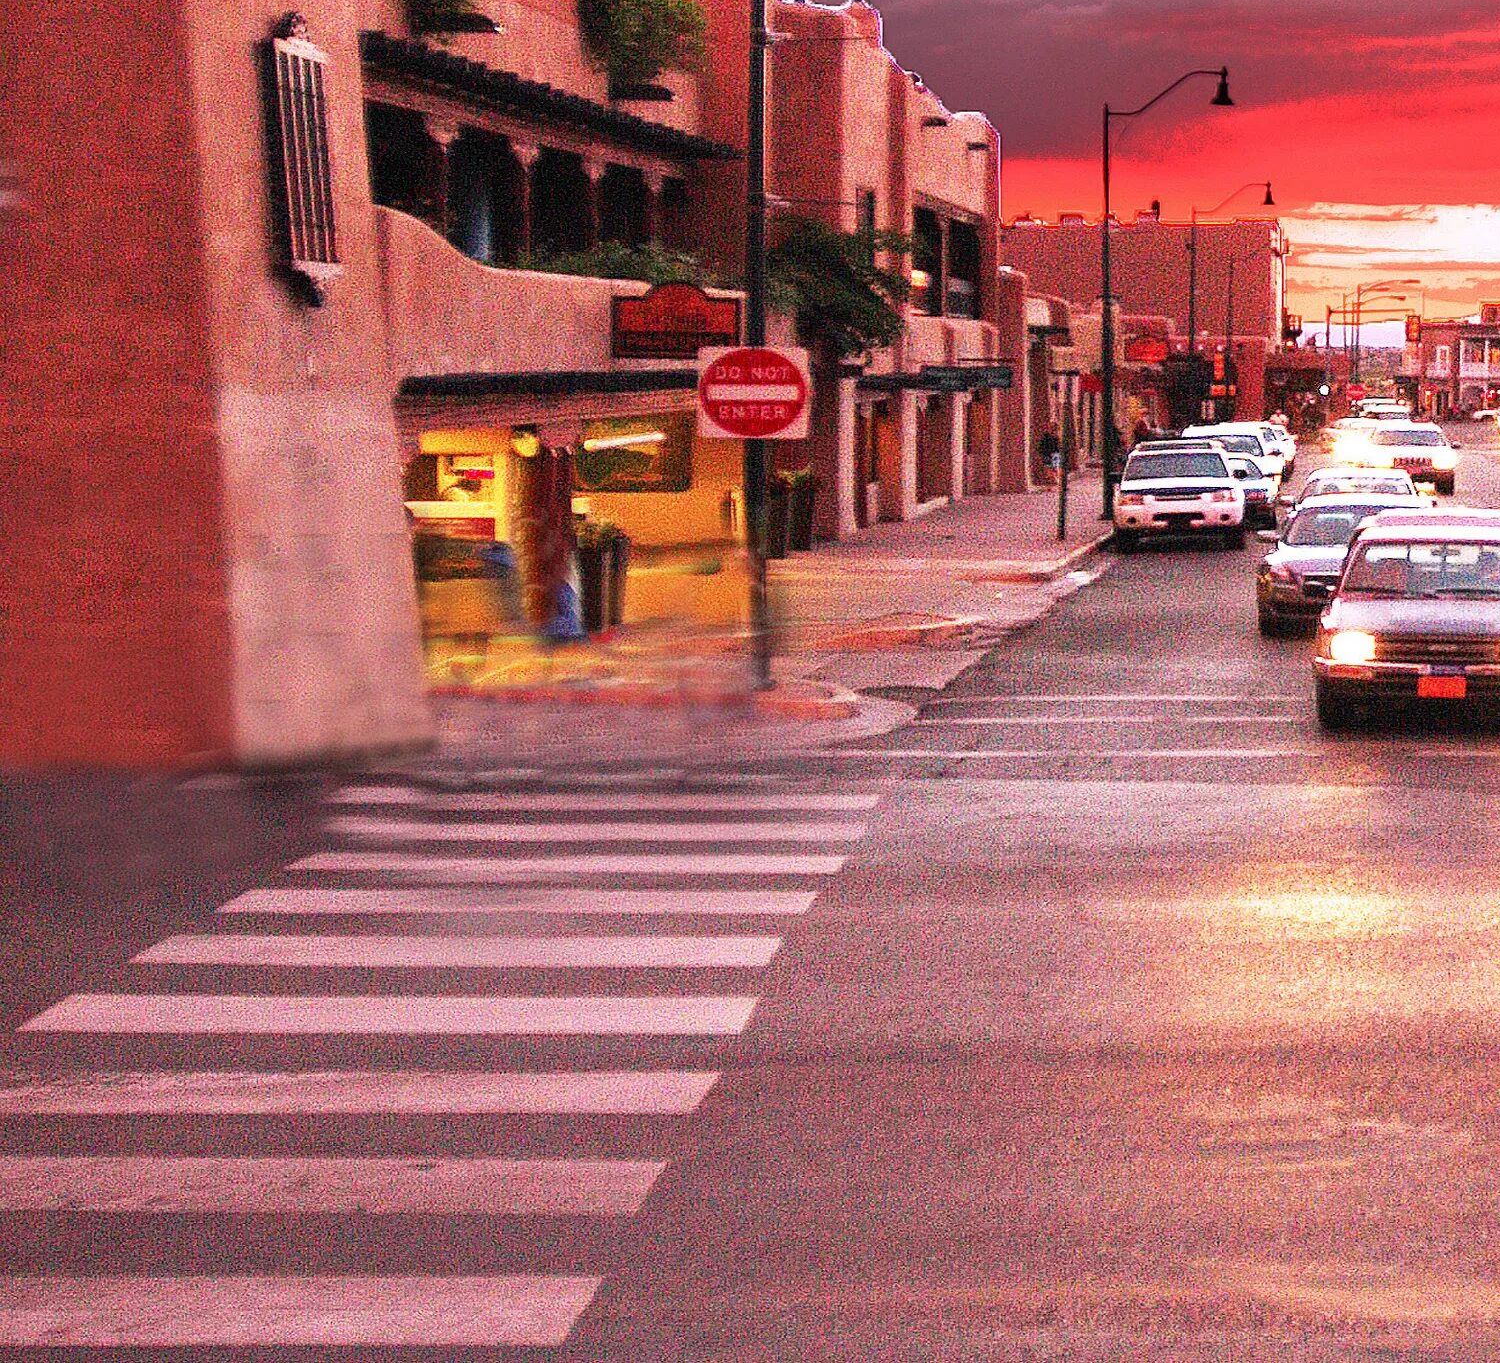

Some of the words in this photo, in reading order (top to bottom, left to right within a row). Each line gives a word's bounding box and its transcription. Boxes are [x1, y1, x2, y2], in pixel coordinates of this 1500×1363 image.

[715, 367, 740, 380] DO
[751, 367, 788, 380] NOT
[719, 406, 786, 420] ENTER
